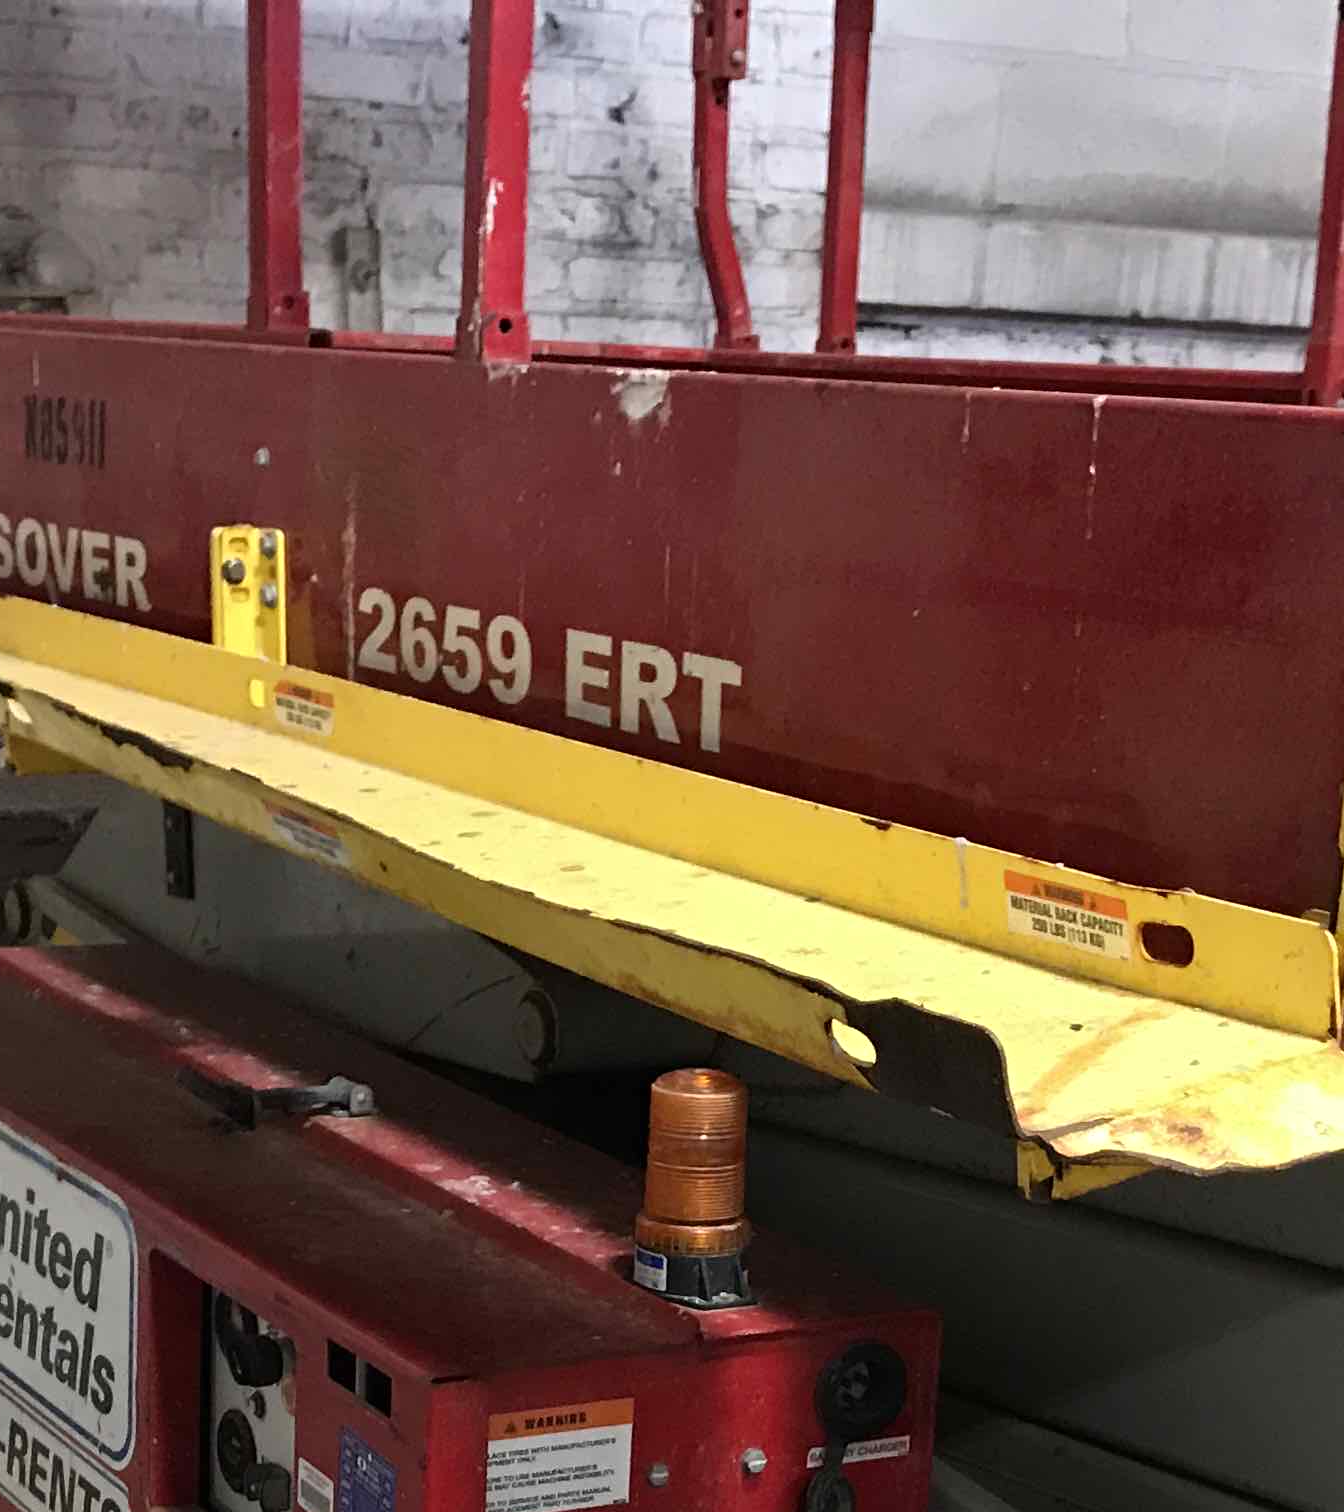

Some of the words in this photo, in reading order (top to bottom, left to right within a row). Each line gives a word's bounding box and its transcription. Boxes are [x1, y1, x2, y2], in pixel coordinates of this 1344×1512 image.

[358, 586, 533, 705] 2659
[565, 628, 743, 753] ERT
[1080, 912, 1124, 937] CAPACITY
[524, 1411, 588, 1430] WARNING
